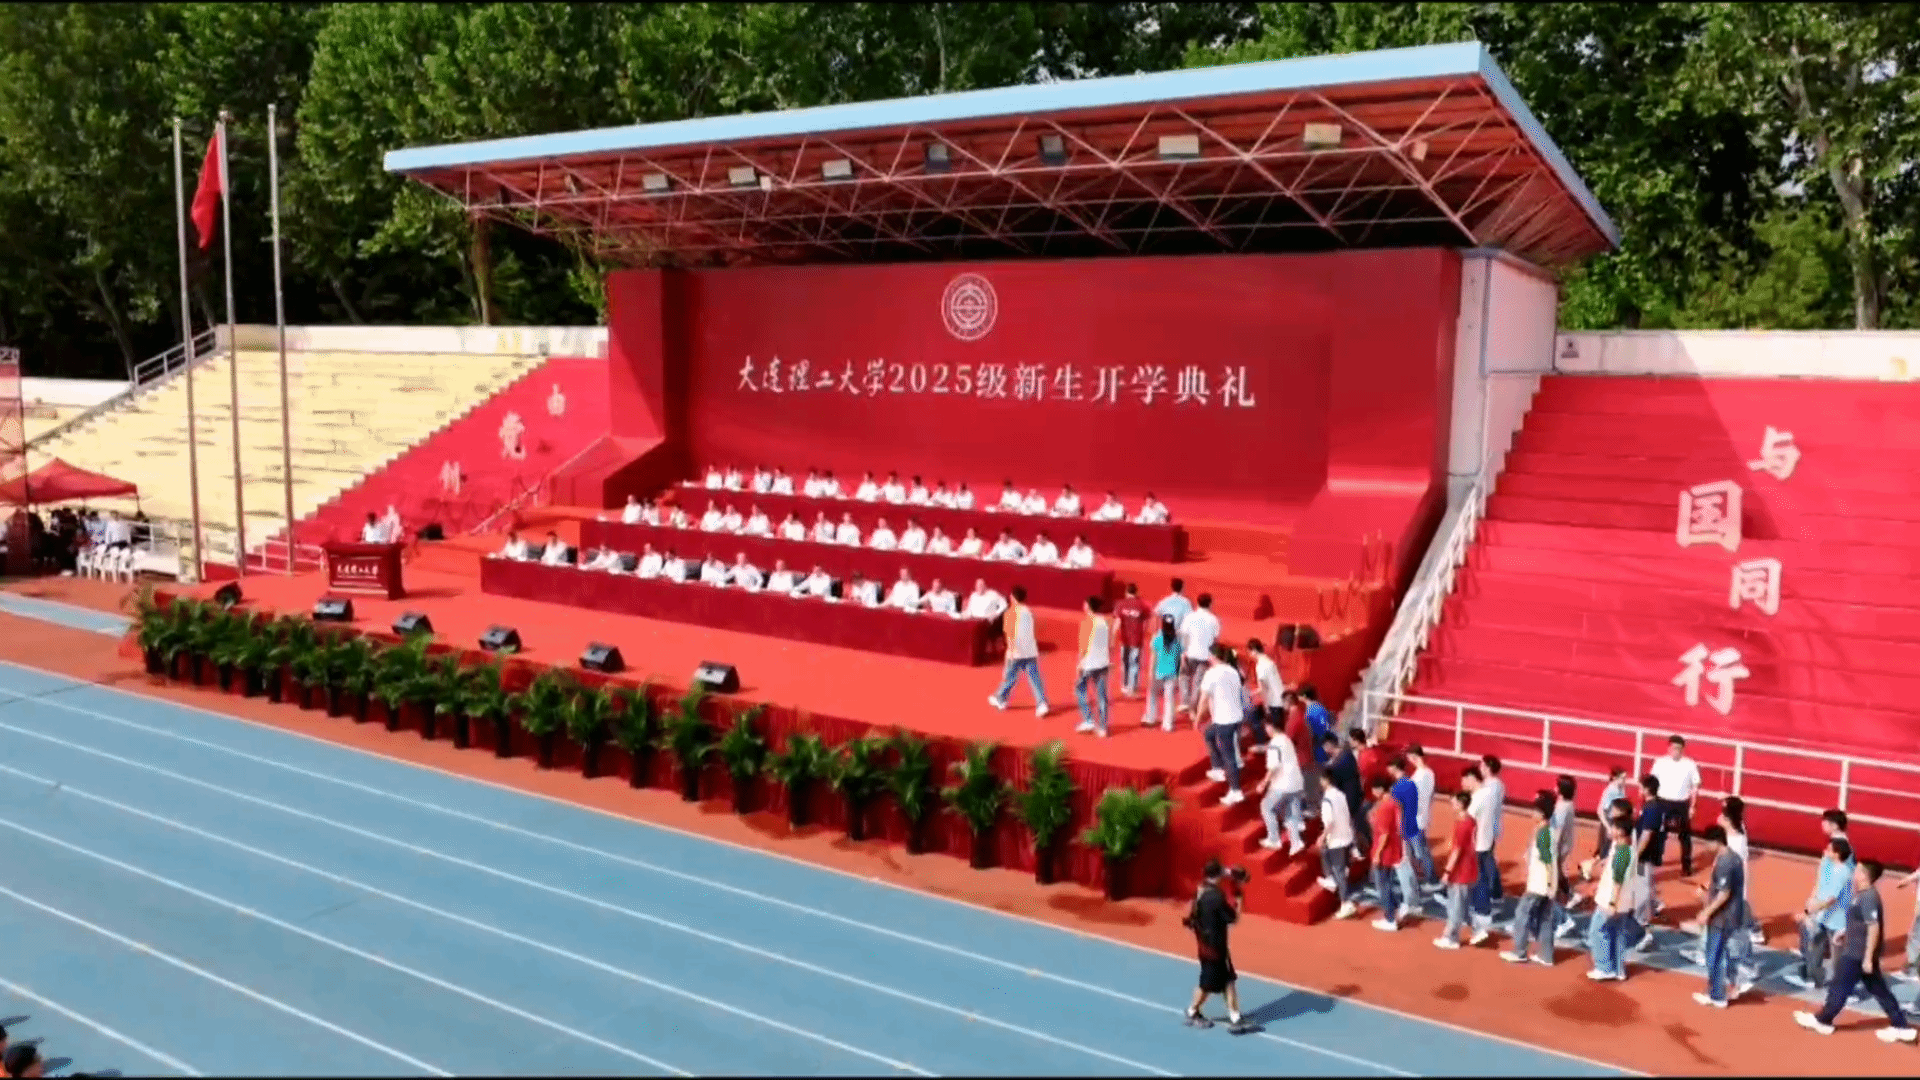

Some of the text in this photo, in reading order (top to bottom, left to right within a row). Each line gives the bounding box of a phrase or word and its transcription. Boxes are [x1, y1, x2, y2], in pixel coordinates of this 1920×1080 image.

[737, 354, 1256, 408] 大连理工大学2025级新生开学典礼
